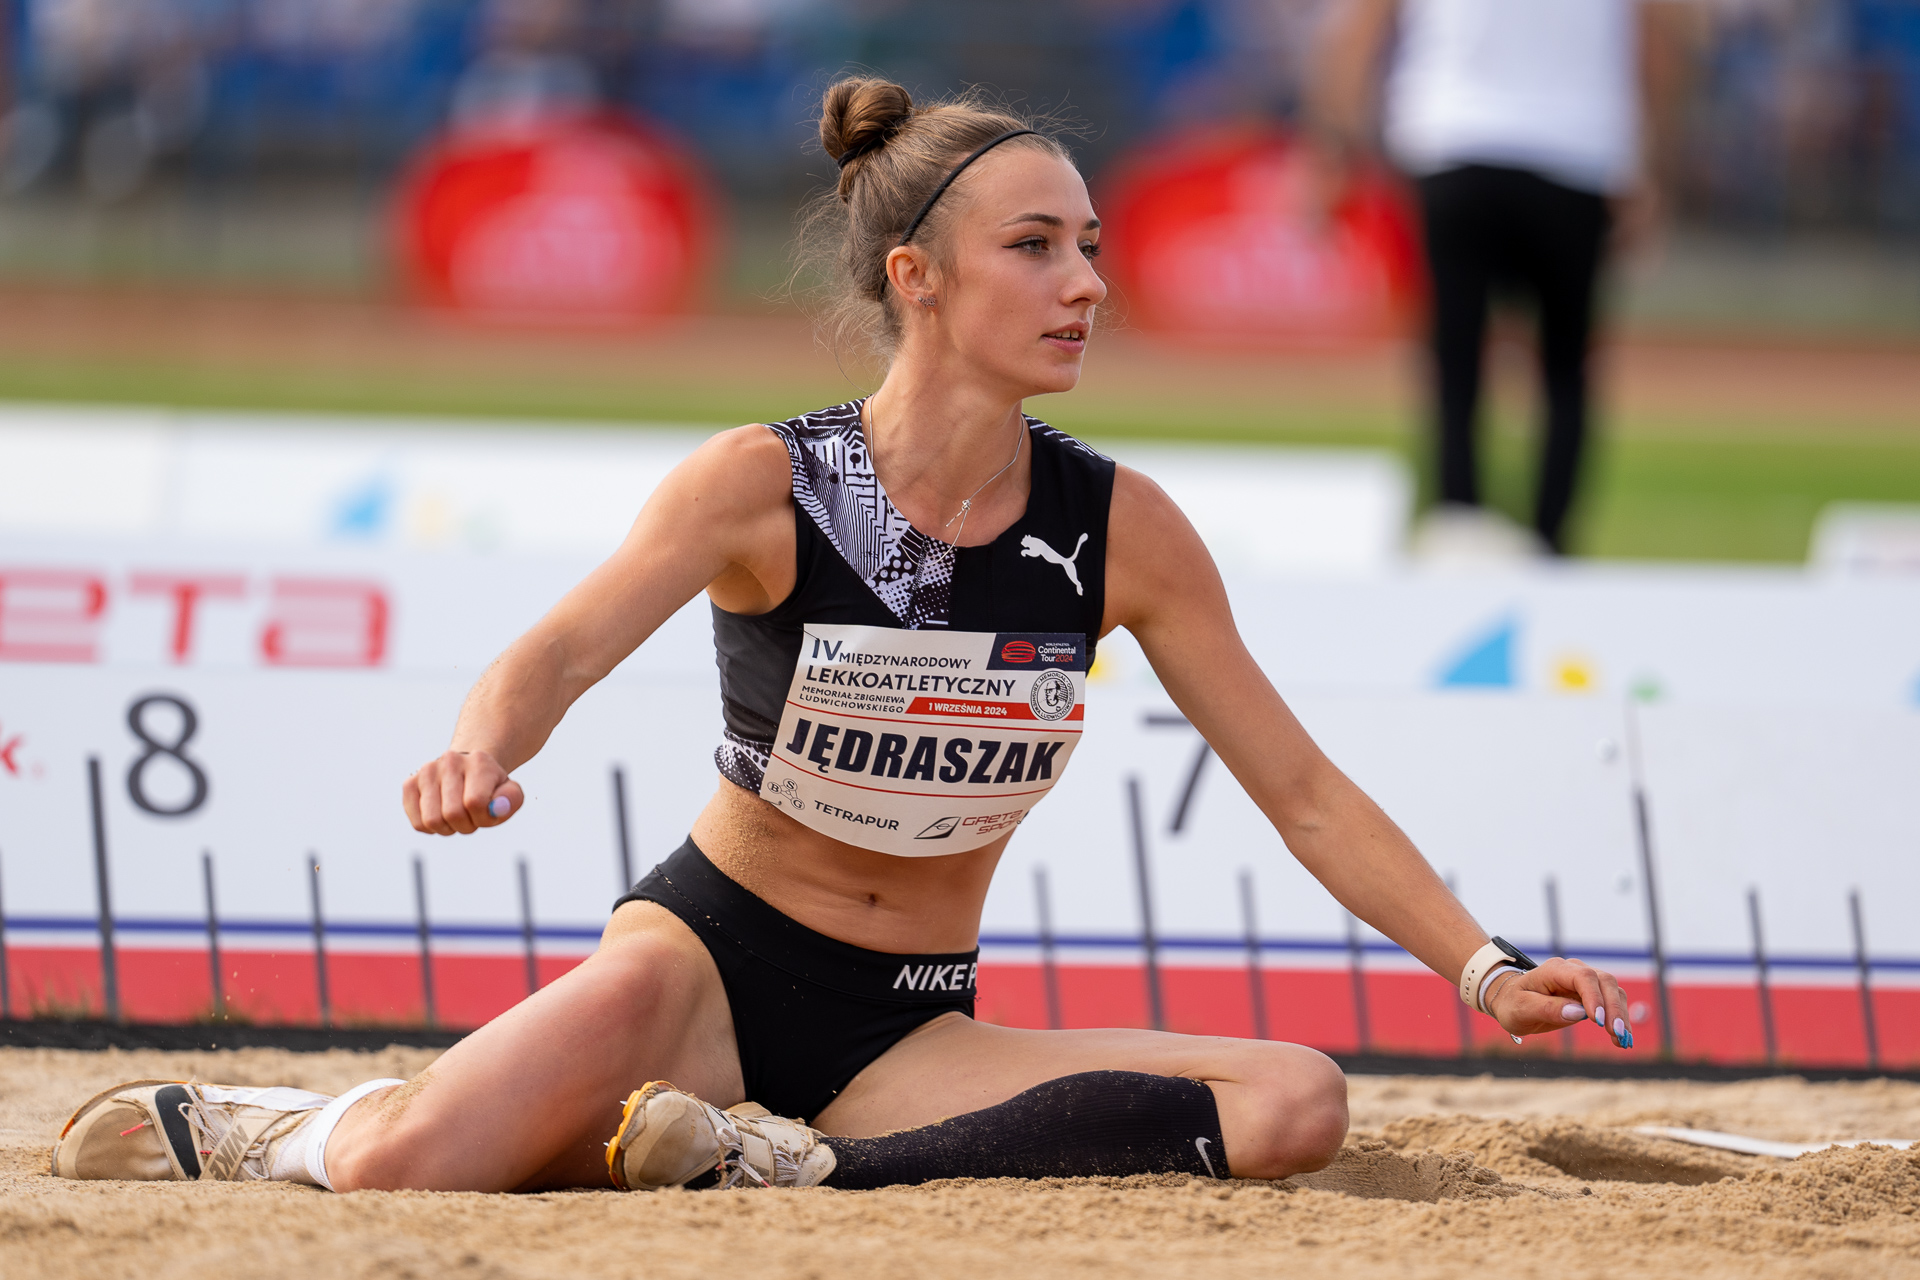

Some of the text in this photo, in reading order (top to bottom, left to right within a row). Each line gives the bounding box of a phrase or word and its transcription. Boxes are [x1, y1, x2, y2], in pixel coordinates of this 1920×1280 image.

[812, 639, 971, 670] IV MIĘDZYNARODOWY
[1038, 645, 1076, 654] Continental
[802, 685, 905, 705] MEMORIAŁ ZBIGNIEWA
[806, 665, 1016, 697] LEKKOATLETYCZNY
[799, 693, 904, 714] LUDWICHOWSKIEGO
[928, 702, 1007, 716] 1 WRZEŚNIA 2024
[125, 692, 209, 818] 8
[786, 718, 1065, 783] JĘDRASZAK
[1143, 712, 1213, 834] 7
[814, 799, 899, 831] TETRAPUR
